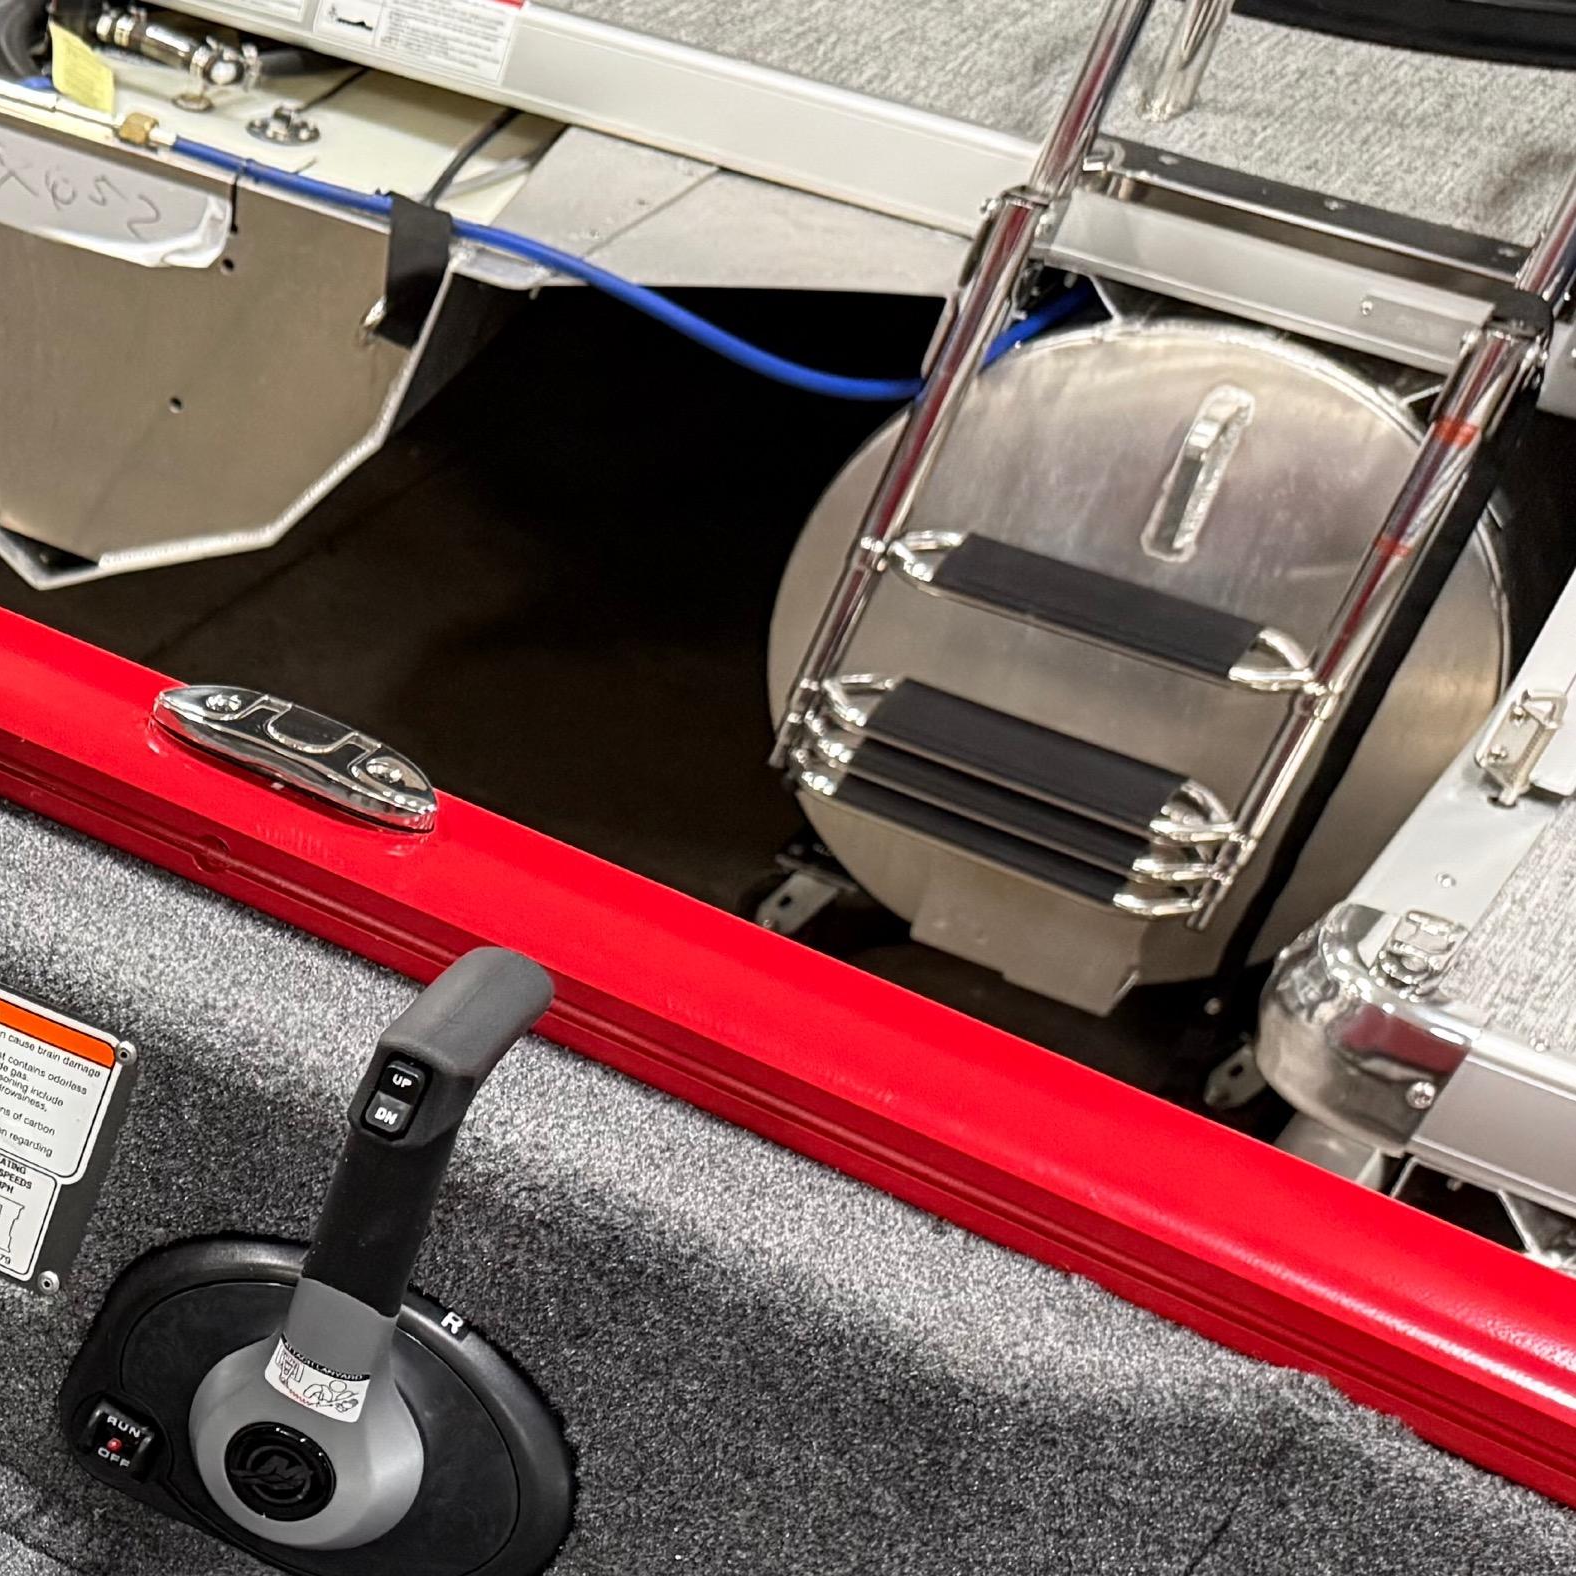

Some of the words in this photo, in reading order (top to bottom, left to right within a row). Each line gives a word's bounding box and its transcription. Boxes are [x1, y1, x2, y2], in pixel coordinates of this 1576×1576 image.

[7, 1034, 35, 1051] cause
[36, 1045, 61, 1062] brain
[61, 1056, 100, 1080] damage
[7, 1054, 46, 1078] contains
[47, 1071, 87, 1095] odorless
[9, 1068, 29, 1082] gas.
[392, 1073, 412, 1088] UP
[30, 1086, 64, 1107] include
[374, 1106, 398, 1125] DN
[440, 1311, 464, 1334] R
[107, 1415, 141, 1438] RUN
[97, 1447, 131, 1467] OFF
